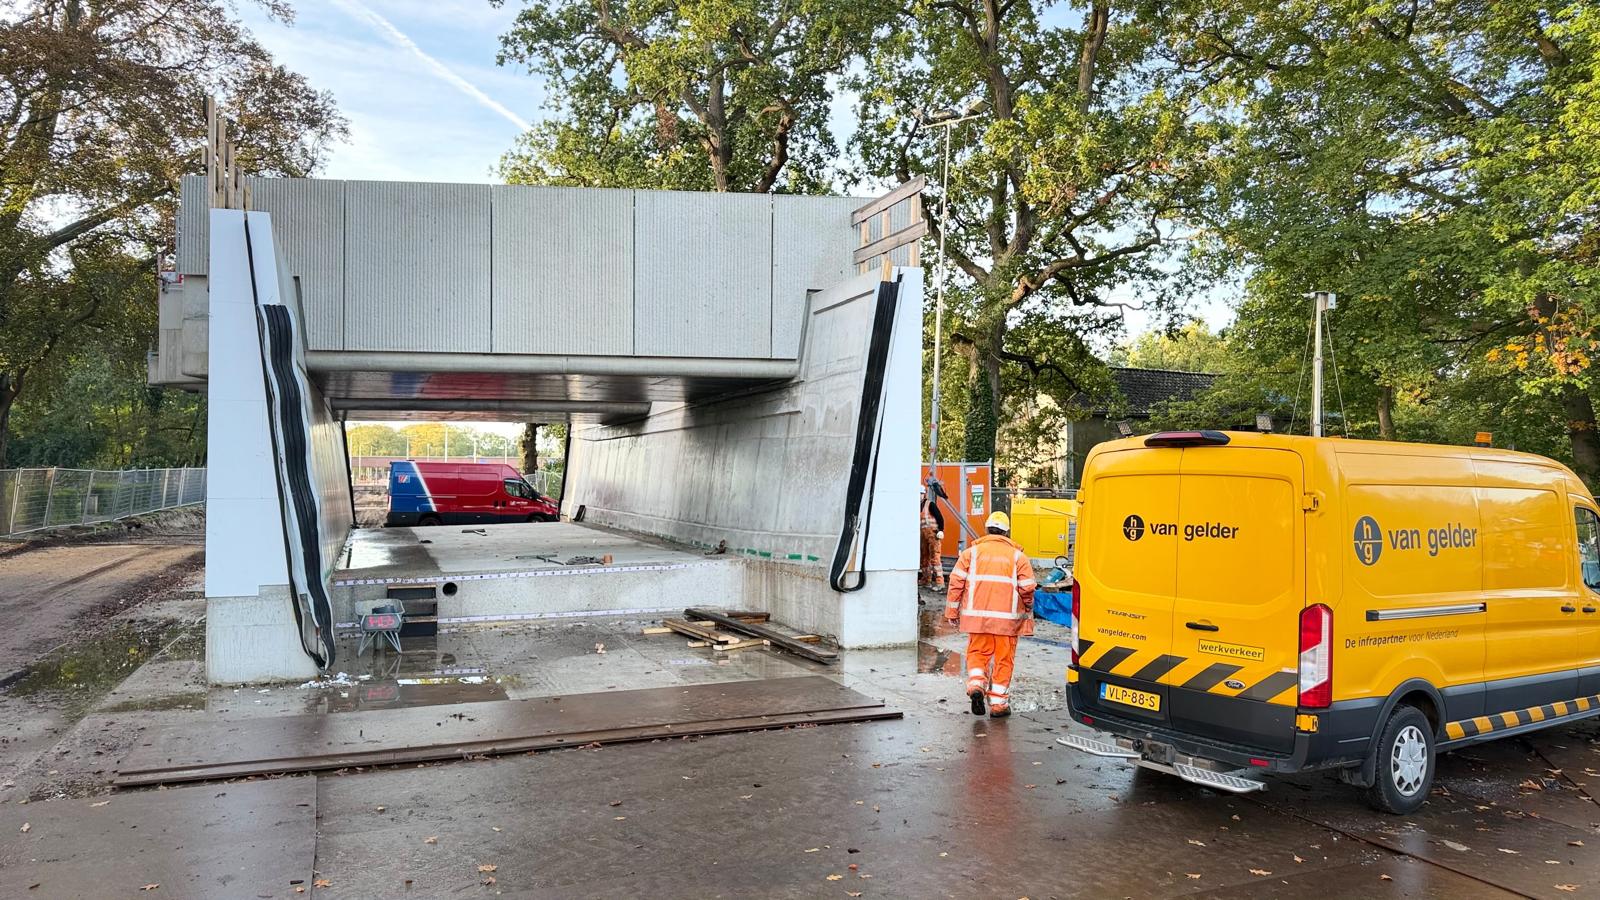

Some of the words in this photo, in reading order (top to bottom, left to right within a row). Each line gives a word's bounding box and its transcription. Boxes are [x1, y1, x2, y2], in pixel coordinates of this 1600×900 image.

[1150, 523, 1178, 536] van
[1184, 522, 1239, 541] gelder
[1388, 529, 1421, 550] van
[1428, 522, 1477, 557] gelder
[1106, 609, 1147, 620] TRANSIT
[1097, 626, 1147, 641] vangelder.com
[1345, 638, 1356, 649] De
[1358, 634, 1407, 647] infrapartner
[1408, 633, 1424, 642] voor
[1425, 629, 1459, 640] Nederland
[1200, 642, 1263, 659] werkverkeer
[1108, 686, 1156, 708] VLP-88-S
